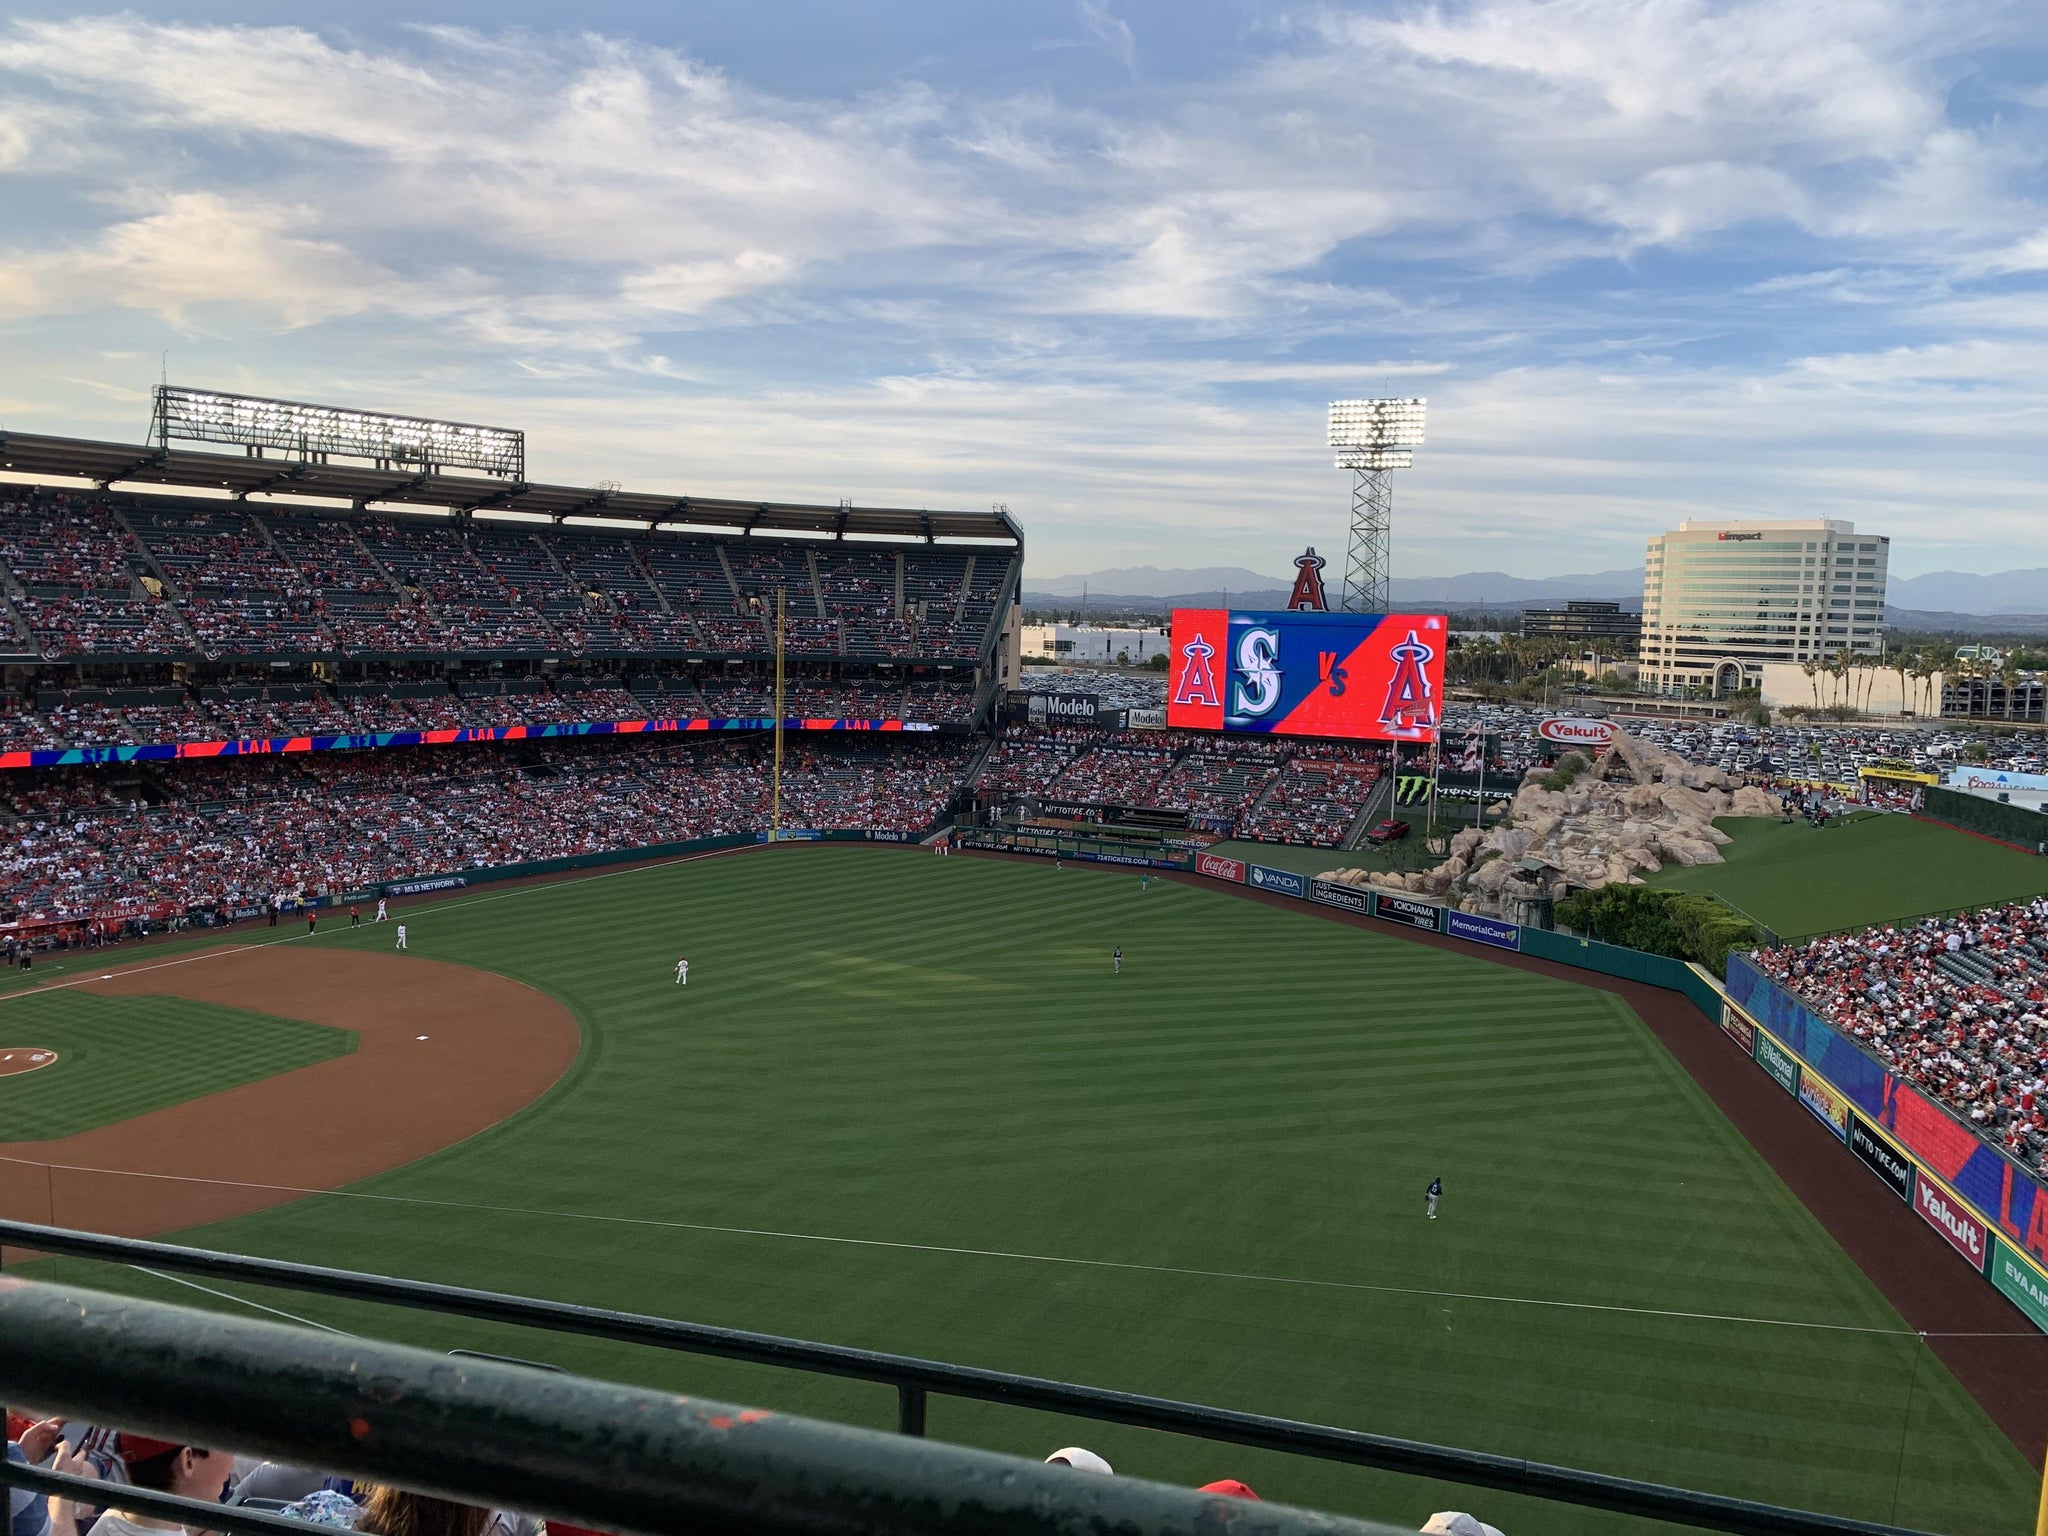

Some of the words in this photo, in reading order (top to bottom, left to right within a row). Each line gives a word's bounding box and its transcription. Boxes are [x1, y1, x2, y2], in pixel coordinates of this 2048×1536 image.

[1047, 696, 1095, 716] Modelo
[1134, 711, 1162, 724] Modelo
[238, 739, 271, 754] LAA
[469, 728, 494, 741] LAA
[654, 720, 678, 731] LAA
[845, 720, 870, 730] LAA
[1553, 724, 1609, 738] Yakult
[1436, 787, 1513, 799] MONSTER
[1045, 804, 1097, 816] NITTOTIRE.CO
[874, 831, 899, 841] Modelo
[1097, 855, 1149, 865] 714TICKETS.COM
[404, 885, 420, 893] MLB
[421, 880, 455, 891] NETWORK
[1264, 872, 1300, 889] VANDA
[1316, 881, 1331, 891] JUST
[1315, 889, 1362, 907] INGREDIENTS
[235, 908, 258, 918] Modelo
[1393, 900, 1435, 918] YOKOHAMA
[1414, 916, 1435, 928] TIRES
[1451, 919, 1506, 939] MemorialCare
[1767, 1045, 1794, 1079] National
[1853, 1128, 1874, 1154] NITTO
[1875, 1149, 1908, 1185] TIRE.COM
[1919, 1180, 1980, 1255] Yakult
[2005, 1260, 2029, 1292] EVA
